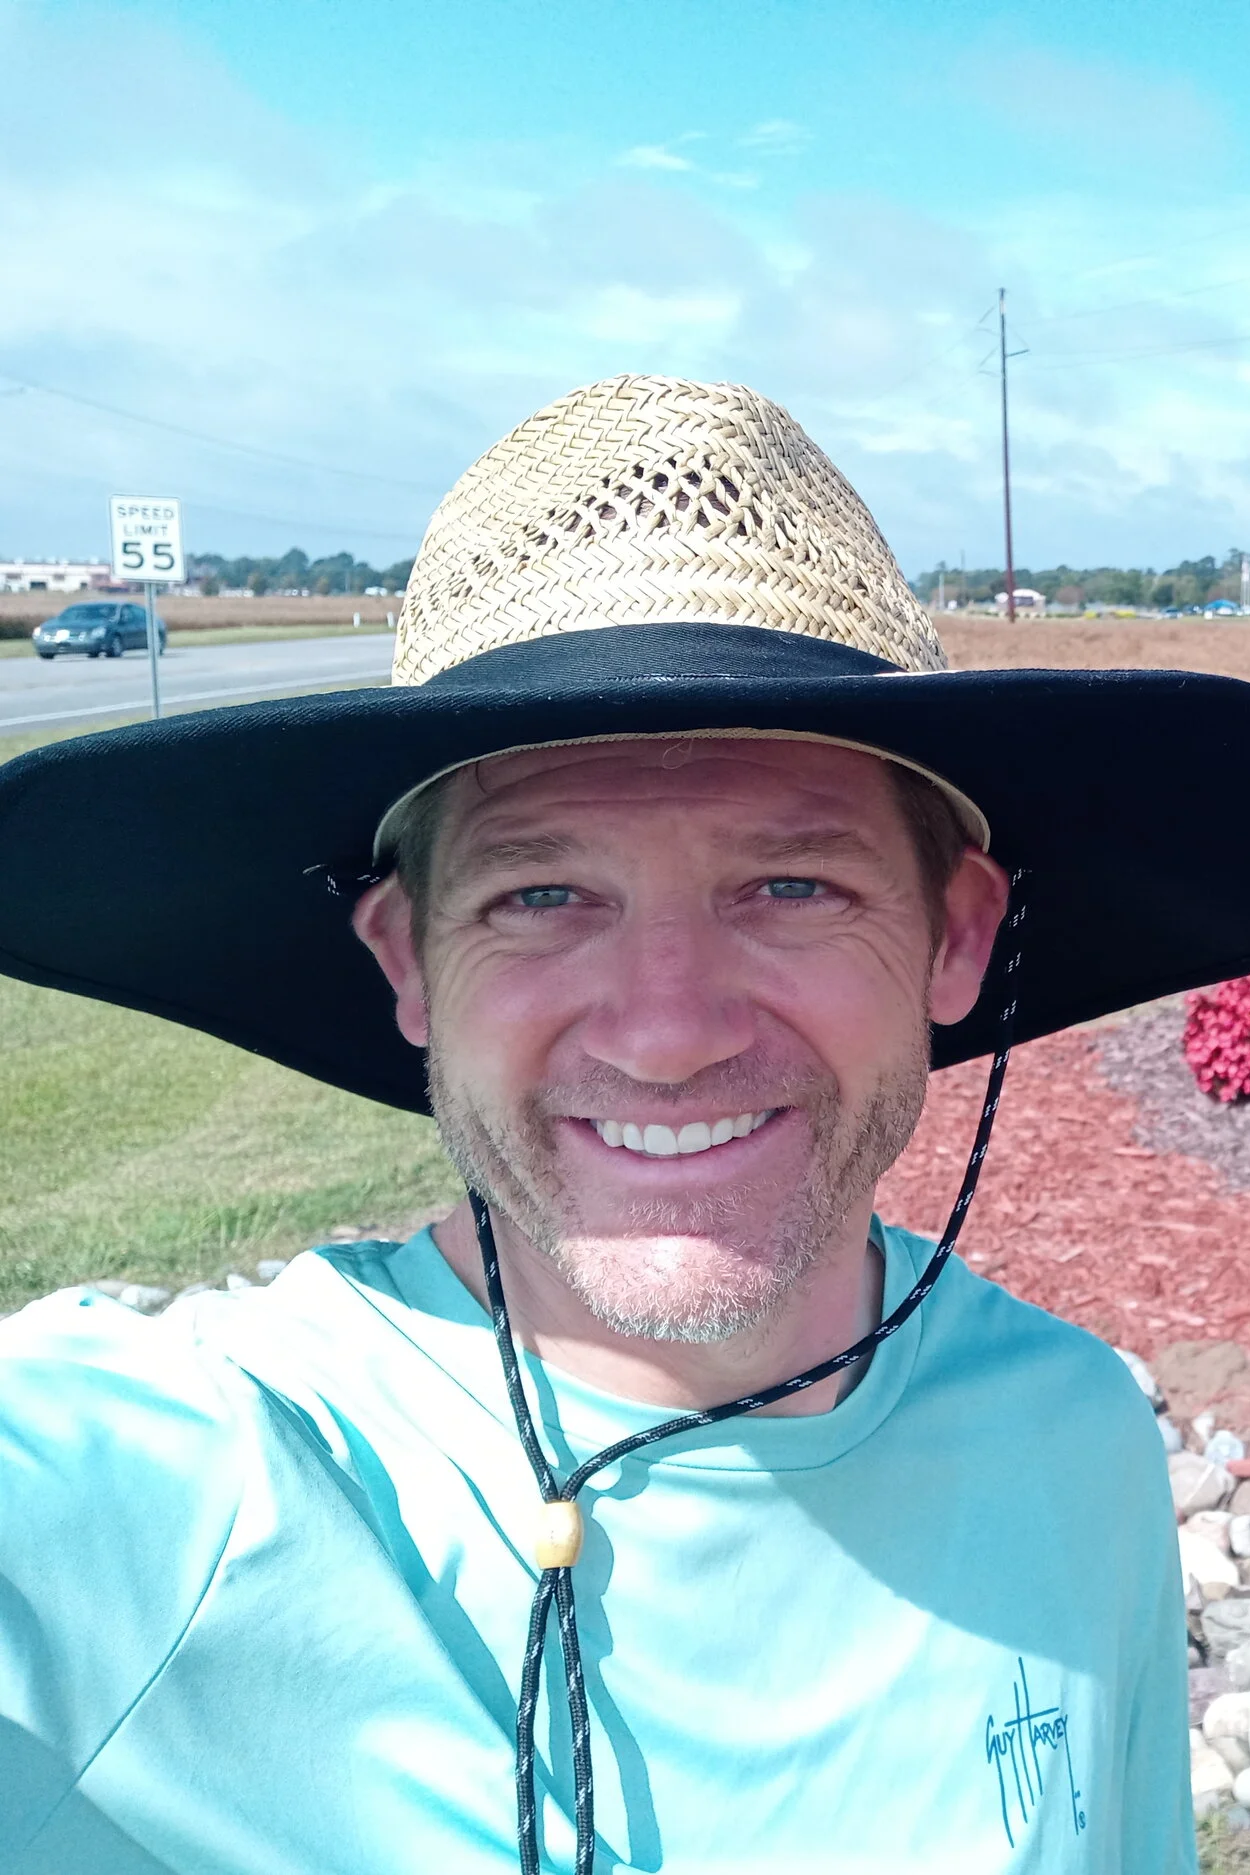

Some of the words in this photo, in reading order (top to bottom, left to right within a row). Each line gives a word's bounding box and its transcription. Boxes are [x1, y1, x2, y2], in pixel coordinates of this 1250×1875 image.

[117, 504, 175, 521] SPEED
[123, 523, 169, 537] LIMIT
[122, 541, 175, 571] 55
